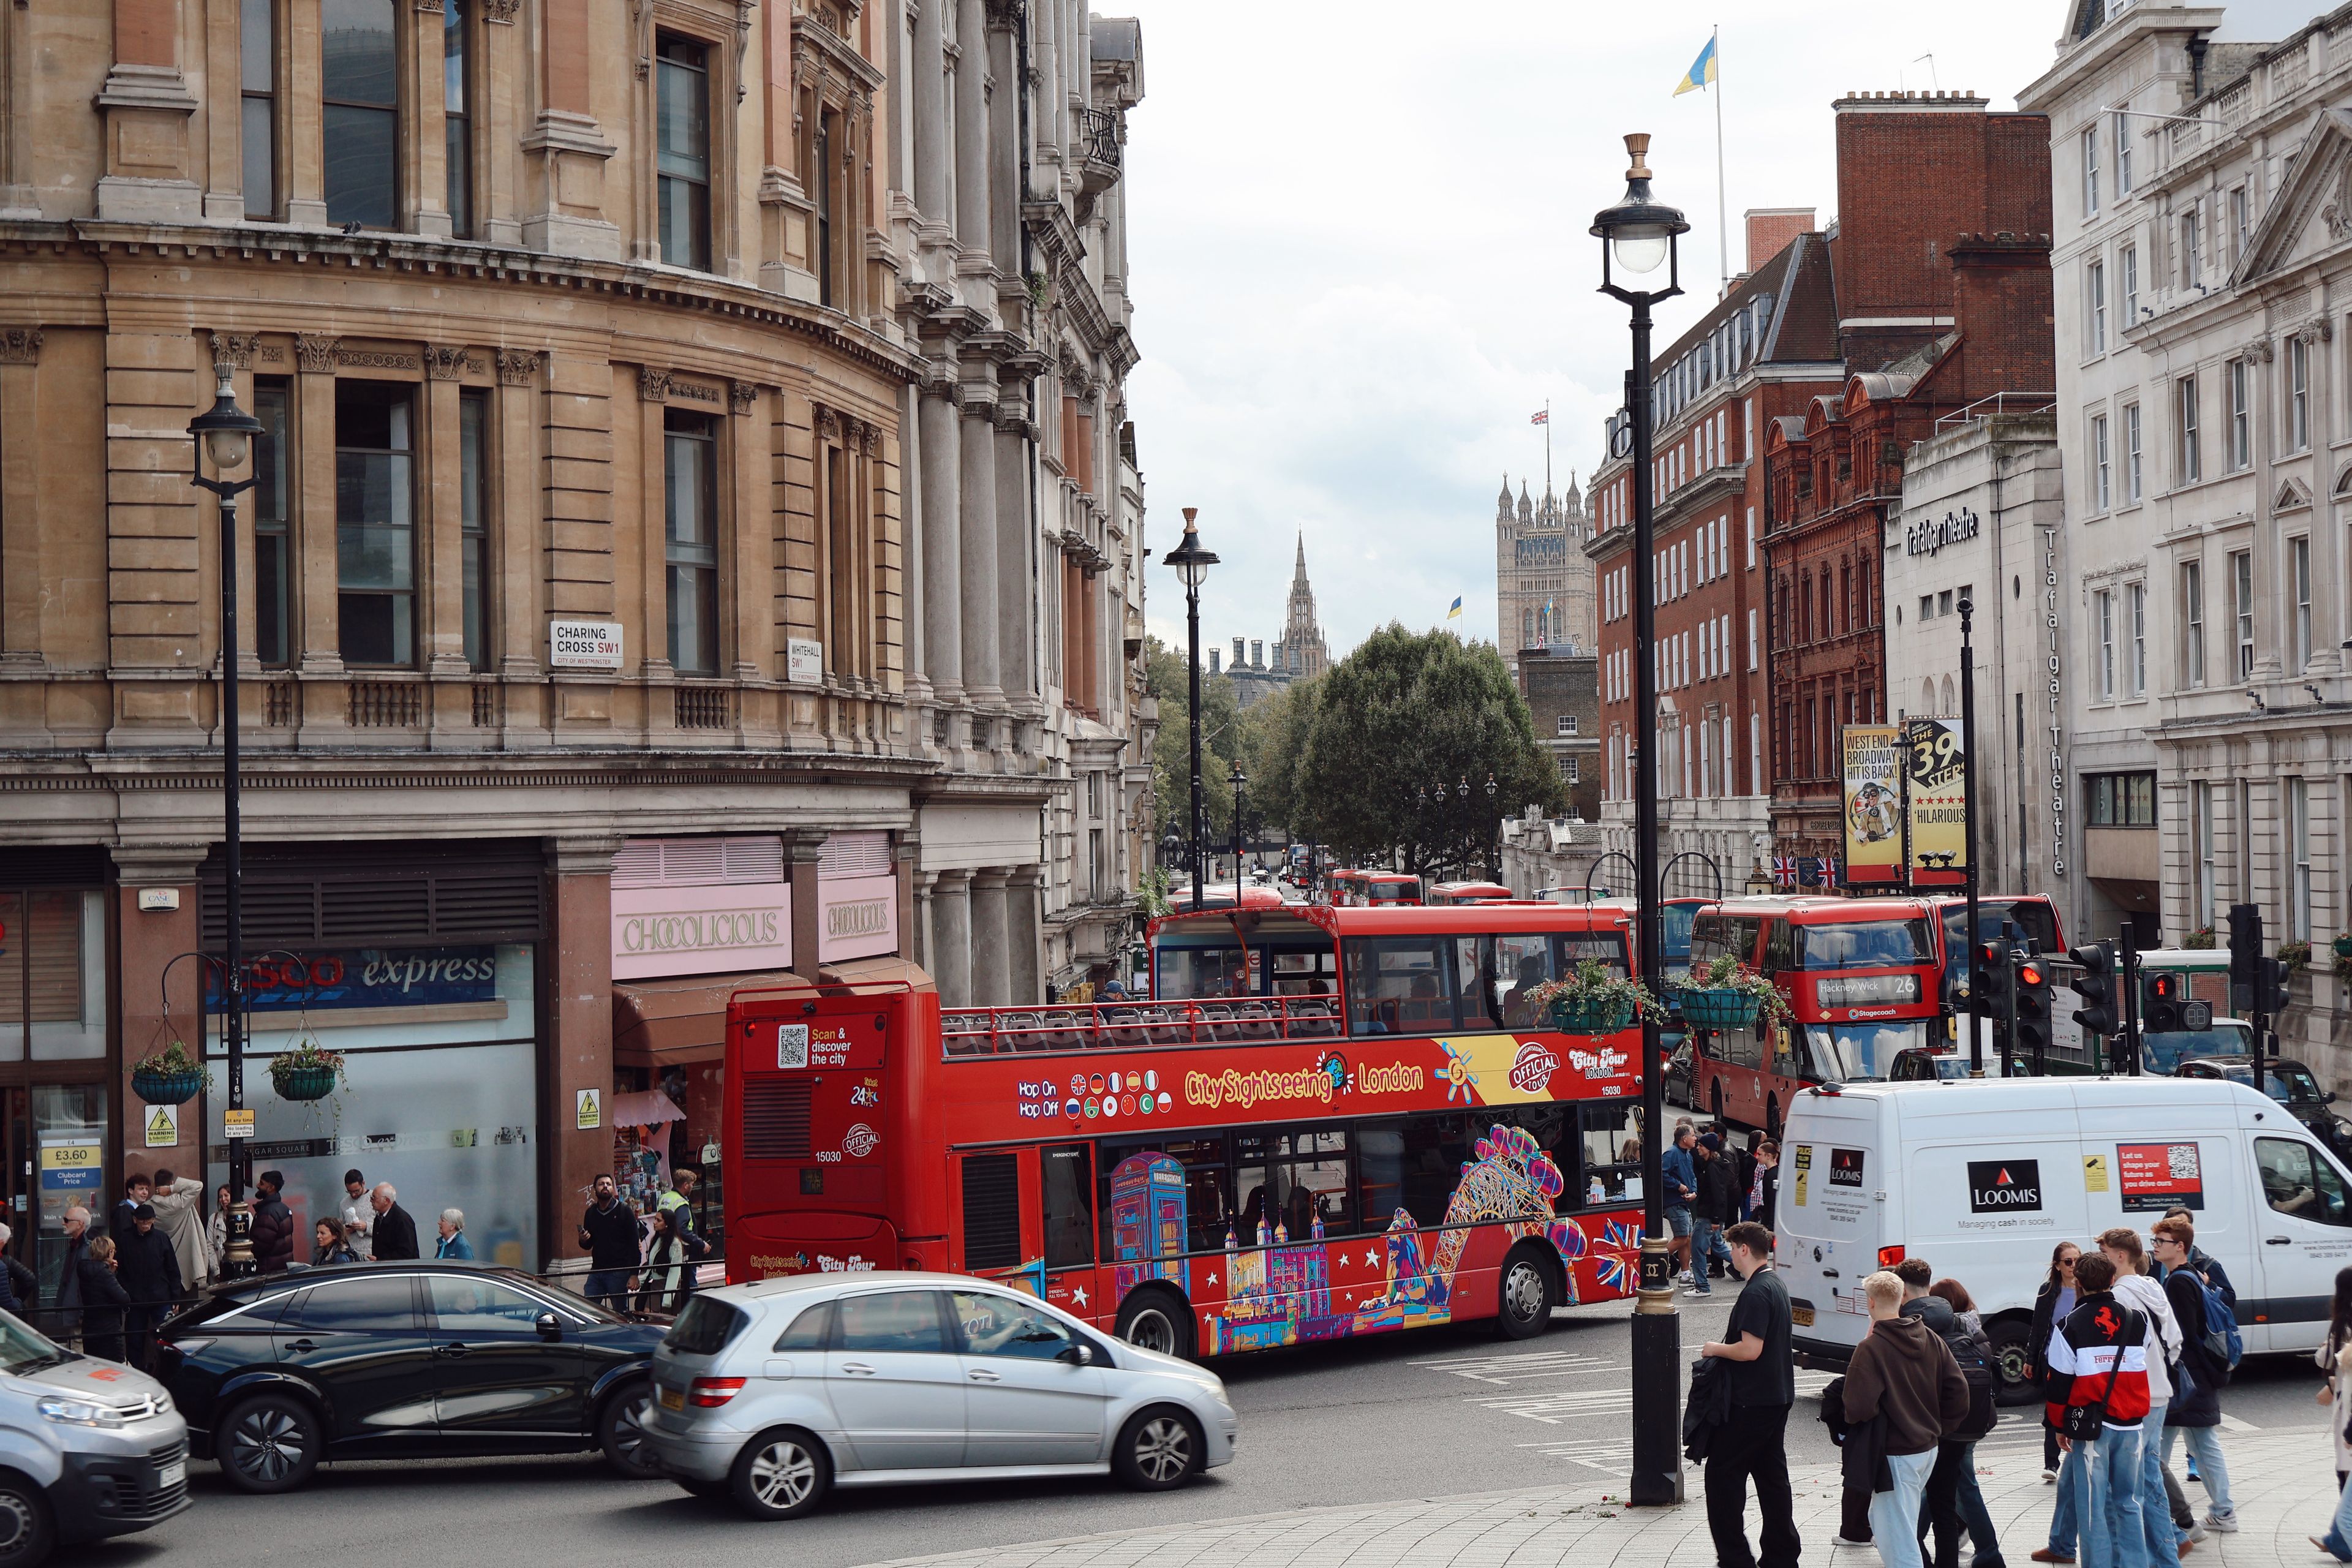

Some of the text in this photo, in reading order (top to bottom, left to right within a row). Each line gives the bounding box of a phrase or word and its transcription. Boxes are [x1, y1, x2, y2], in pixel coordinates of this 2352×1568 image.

[1905, 508, 1974, 557] Trafalgar Theatre
[557, 627, 606, 639] CHARING
[557, 641, 618, 654] CROSS SW1
[792, 644, 820, 657] WHITEHALL
[792, 657, 802, 668] SW1
[2045, 530, 2064, 875] Trafalgar Theatre
[1846, 736, 1871, 749] WEST
[1872, 735, 1888, 748] END
[1912, 729, 1933, 742] THE
[1847, 750, 1896, 765] BROADWAY
[1914, 731, 1958, 777] 39
[1847, 765, 1897, 780] HIT IS BACK!
[828, 902, 888, 935] CHOCOLICIOUS
[623, 912, 777, 951] CHOCOLICIOUS
[364, 955, 495, 993] express
[1959, 973, 1969, 981] Parl
[1820, 981, 1879, 994] Hackney Wick
[1895, 977, 1915, 993] 26
[1859, 1009, 1896, 1017] Stagecoach
[812, 1028, 845, 1040] Scan &
[812, 1041, 851, 1052] discover
[812, 1053, 846, 1066] the city
[1518, 1046, 1544, 1063] CITYSIGHTSEEING
[1569, 1047, 1627, 1070] City Tour
[1513, 1055, 1557, 1084] OFFICIAL
[1585, 1067, 1614, 1080] LONDON
[1019, 1080, 1057, 1098] Hop On
[1185, 1061, 1424, 1109] CitySightseeing London
[1528, 1074, 1548, 1090] TOUR
[851, 1086, 865, 1105] 24
[1602, 1086, 1621, 1095] 15030
[1019, 1101, 1059, 1118] Hop Off
[846, 1135, 878, 1149] OFFICIAL
[56, 1150, 87, 1160] £3.60
[221, 1144, 311, 1158] TRGAR SQUARE
[815, 1152, 841, 1162] 15030
[856, 1145, 870, 1155] TOUR
[1831, 1167, 1861, 1182] LOOMIS
[1974, 1189, 2037, 1205] LOOMIS
[1958, 1221, 1996, 1229] Managing
[750, 1255, 802, 1269] CitySightseeing
[816, 1255, 876, 1272] City Tour
[763, 1270, 789, 1280] London
[2095, 1355, 2126, 1363] Ferrai
